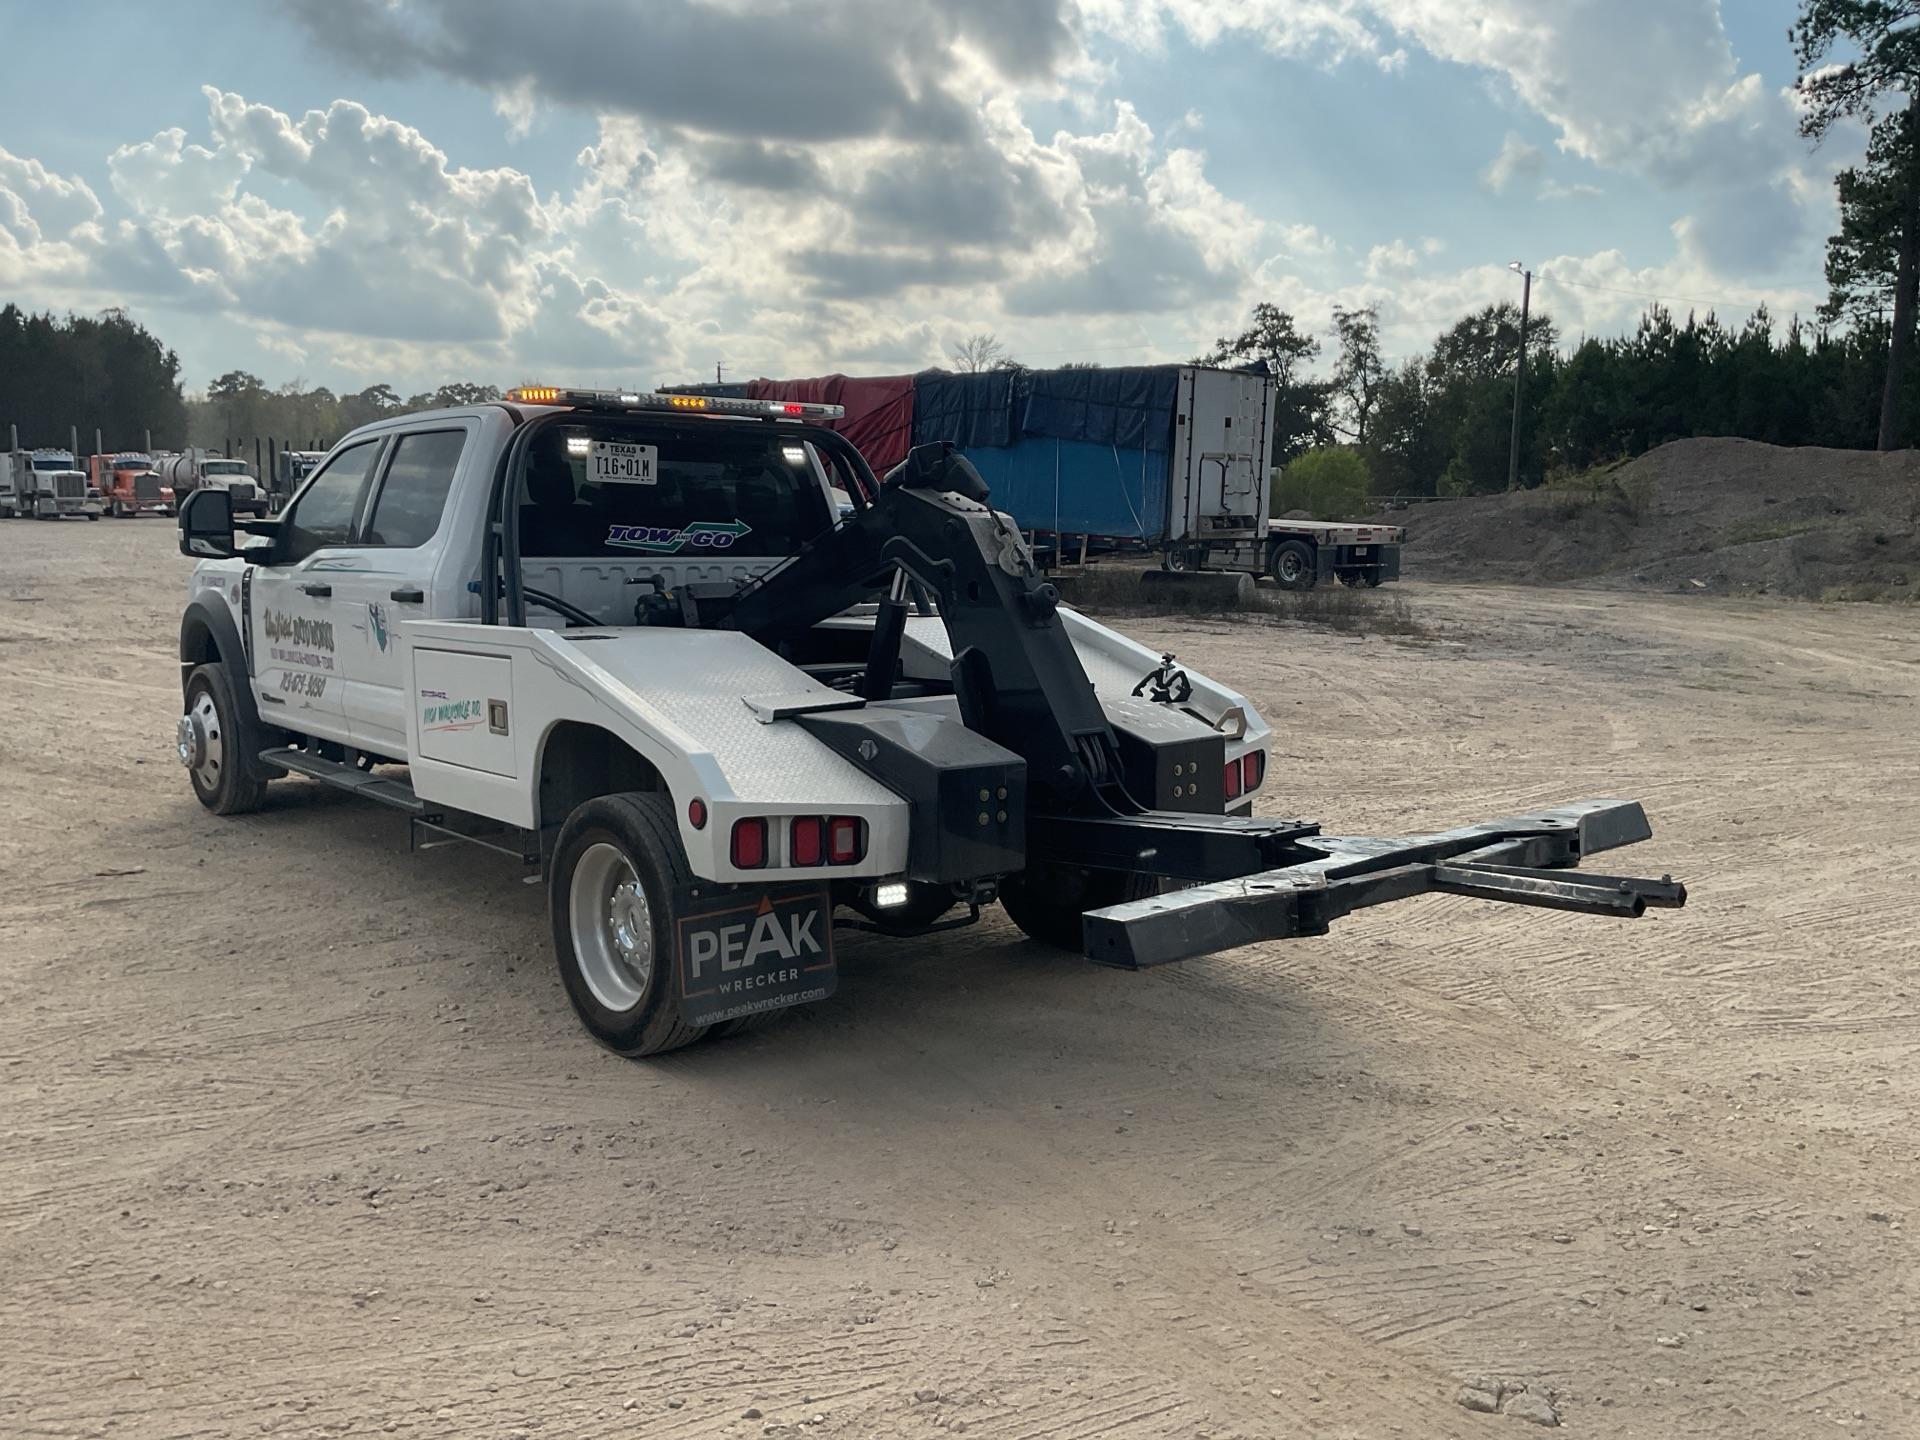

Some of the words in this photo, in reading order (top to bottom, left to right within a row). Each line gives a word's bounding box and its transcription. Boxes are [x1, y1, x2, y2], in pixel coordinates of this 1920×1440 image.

[609, 445, 637, 454] TEXAS
[595, 456, 619, 475] T16
[608, 525, 681, 544] TOW
[691, 530, 735, 548] GO
[690, 900, 822, 978] PEAK
[719, 968, 799, 995] WRECKER
[695, 986, 825, 1026] www.peakwrecker.com
